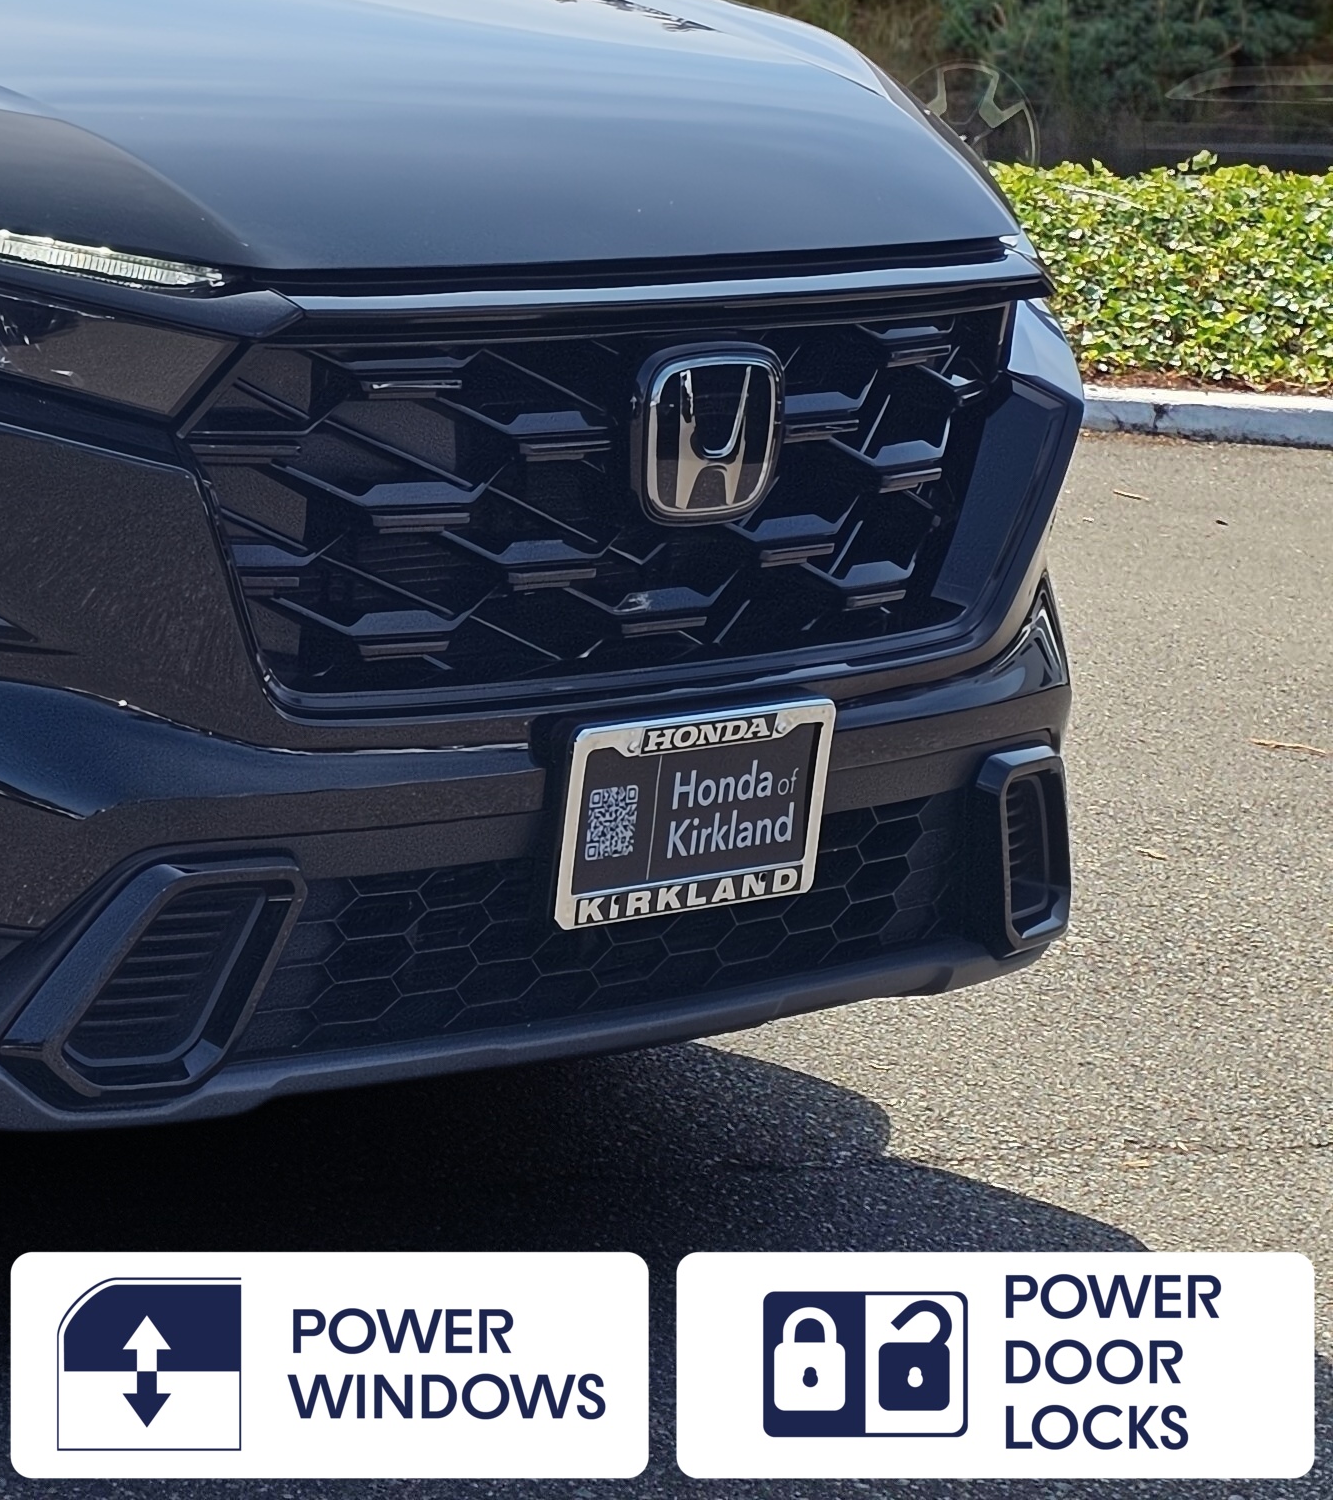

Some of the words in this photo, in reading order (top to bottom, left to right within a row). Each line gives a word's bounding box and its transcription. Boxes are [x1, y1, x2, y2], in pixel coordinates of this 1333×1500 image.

[643, 716, 771, 752] HONDA
[671, 759, 773, 810] Honda
[777, 766, 800, 796] of
[666, 801, 796, 859] Kirkland
[577, 867, 800, 925] KIRKLAND
